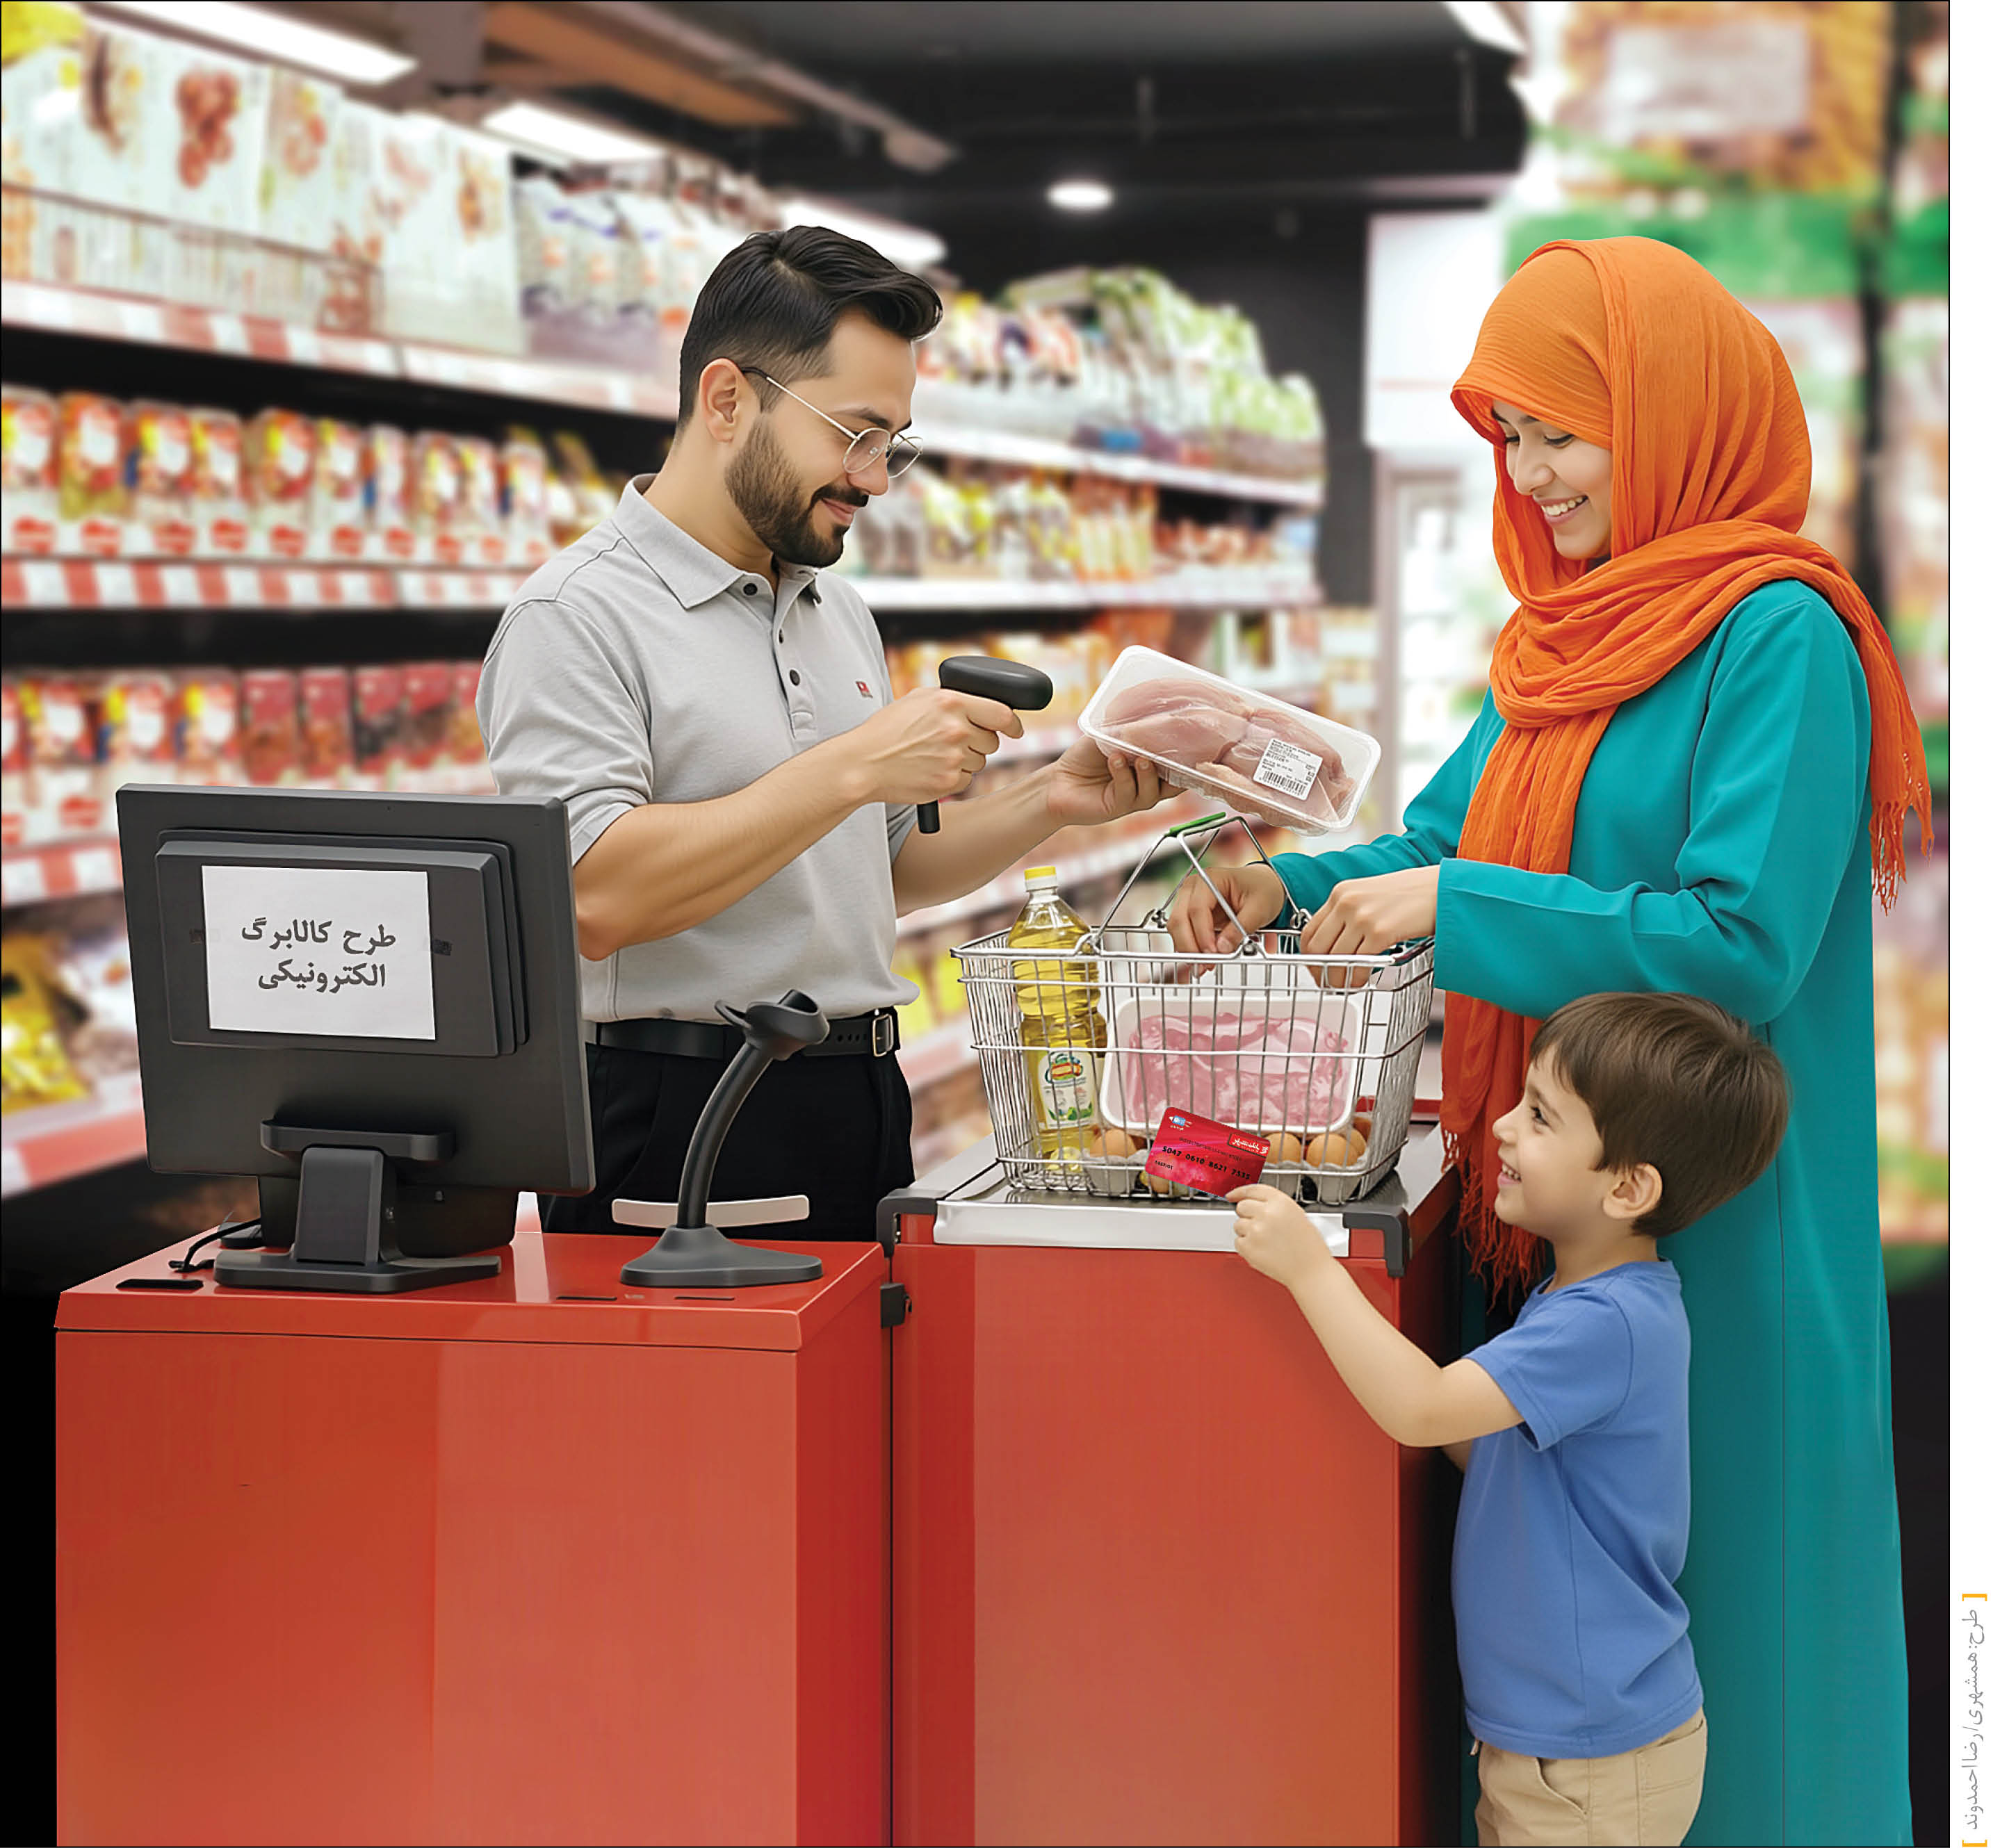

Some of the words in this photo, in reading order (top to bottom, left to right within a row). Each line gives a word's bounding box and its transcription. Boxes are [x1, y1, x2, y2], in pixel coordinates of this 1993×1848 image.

[241, 917, 333, 950] کالابرگ
[343, 924, 397, 956] طرح
[258, 958, 387, 994] الکترونیکی
